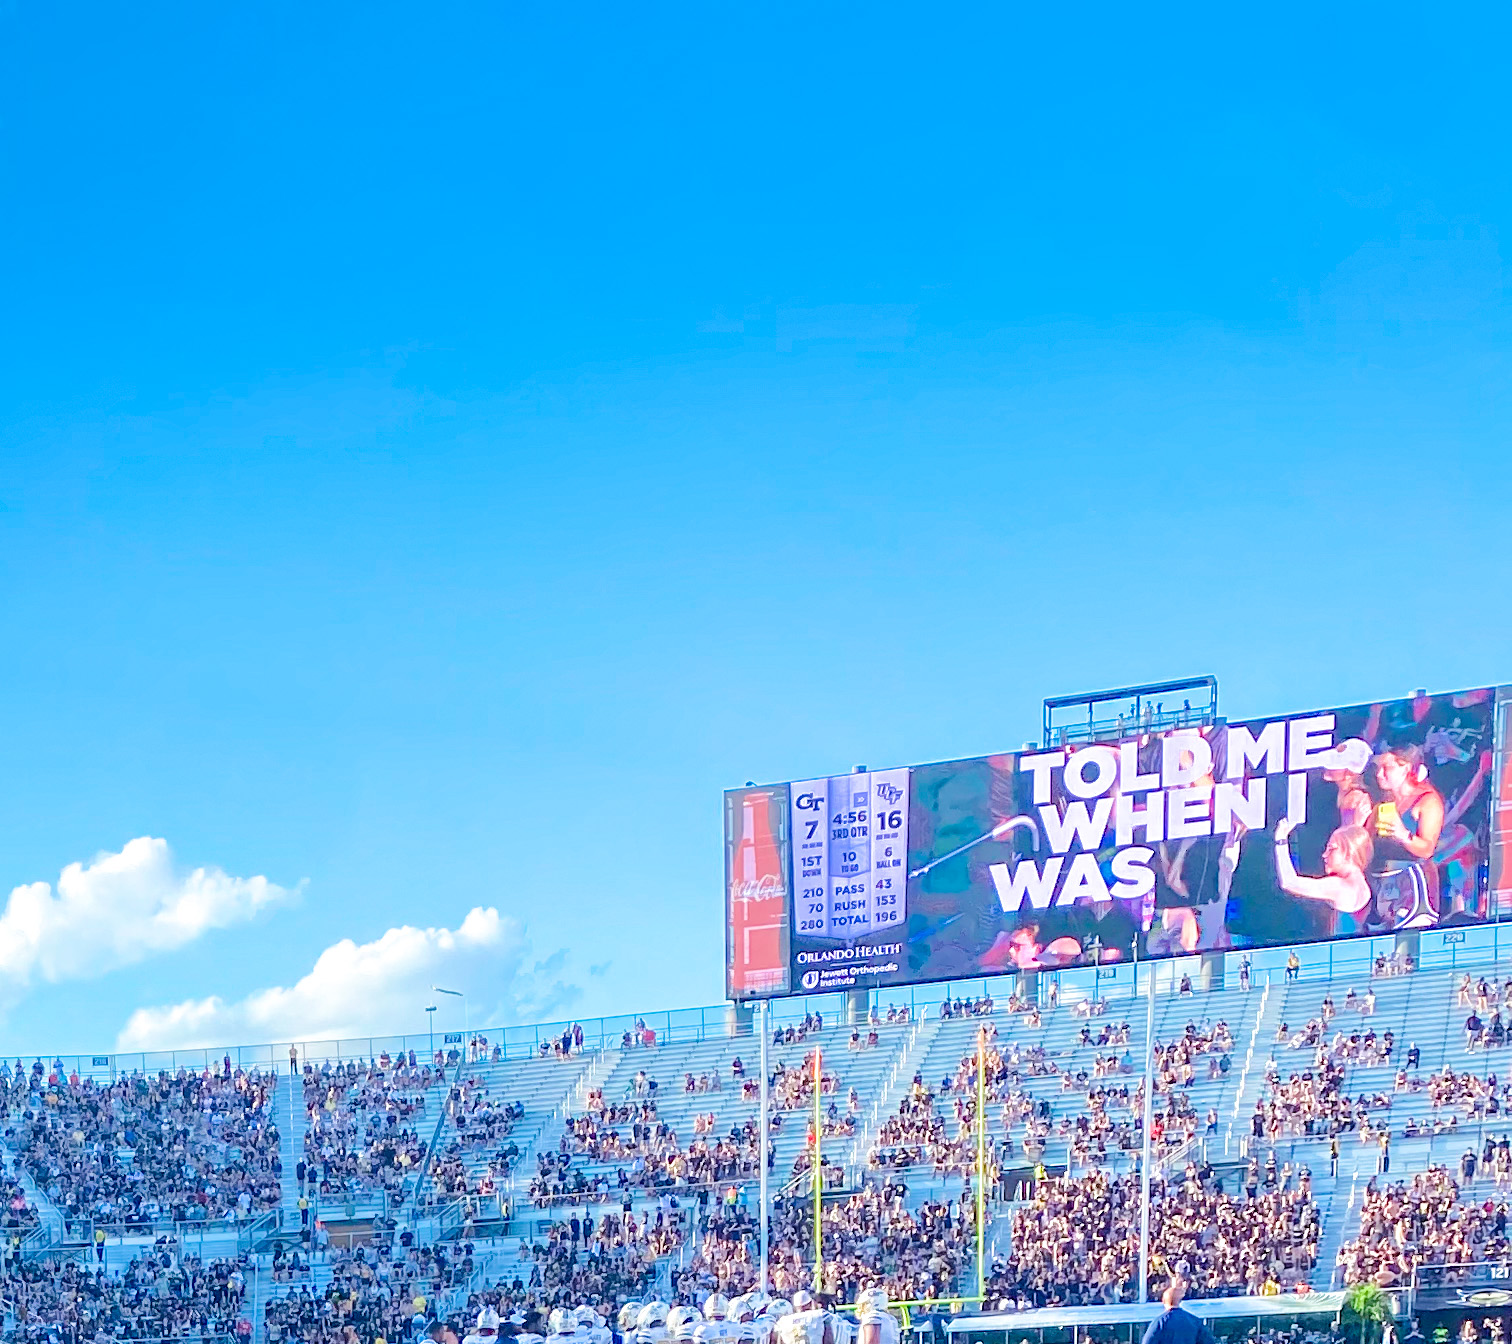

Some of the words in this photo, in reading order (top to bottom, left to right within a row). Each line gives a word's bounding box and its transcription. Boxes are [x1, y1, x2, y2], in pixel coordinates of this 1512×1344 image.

[1019, 735, 1214, 805] TOLD
[1226, 714, 1336, 779] ME
[832, 810, 867, 825] 4:56
[877, 810, 903, 831] 16
[1038, 777, 1267, 854] WHEN
[1288, 772, 1307, 825] I
[805, 820, 819, 840] 7
[832, 827, 848, 840] 3RD
[850, 826, 868, 839] QTR
[801, 855, 823, 867] 1ST
[842, 851, 857, 862] 10
[884, 846, 892, 857] 6
[803, 887, 824, 899] 210
[835, 884, 865, 896] PASS
[876, 879, 892, 889] 43
[989, 846, 1156, 913] WAS
[808, 903, 824, 914] 70
[834, 900, 866, 912] RUSH
[876, 895, 897, 906] 153
[831, 914, 870, 927] TOTAL
[876, 911, 897, 922] 196
[797, 948, 854, 964] ORLANDO
[855, 943, 901, 959] HEALTH
[1491, 1267, 1510, 1279] 121
